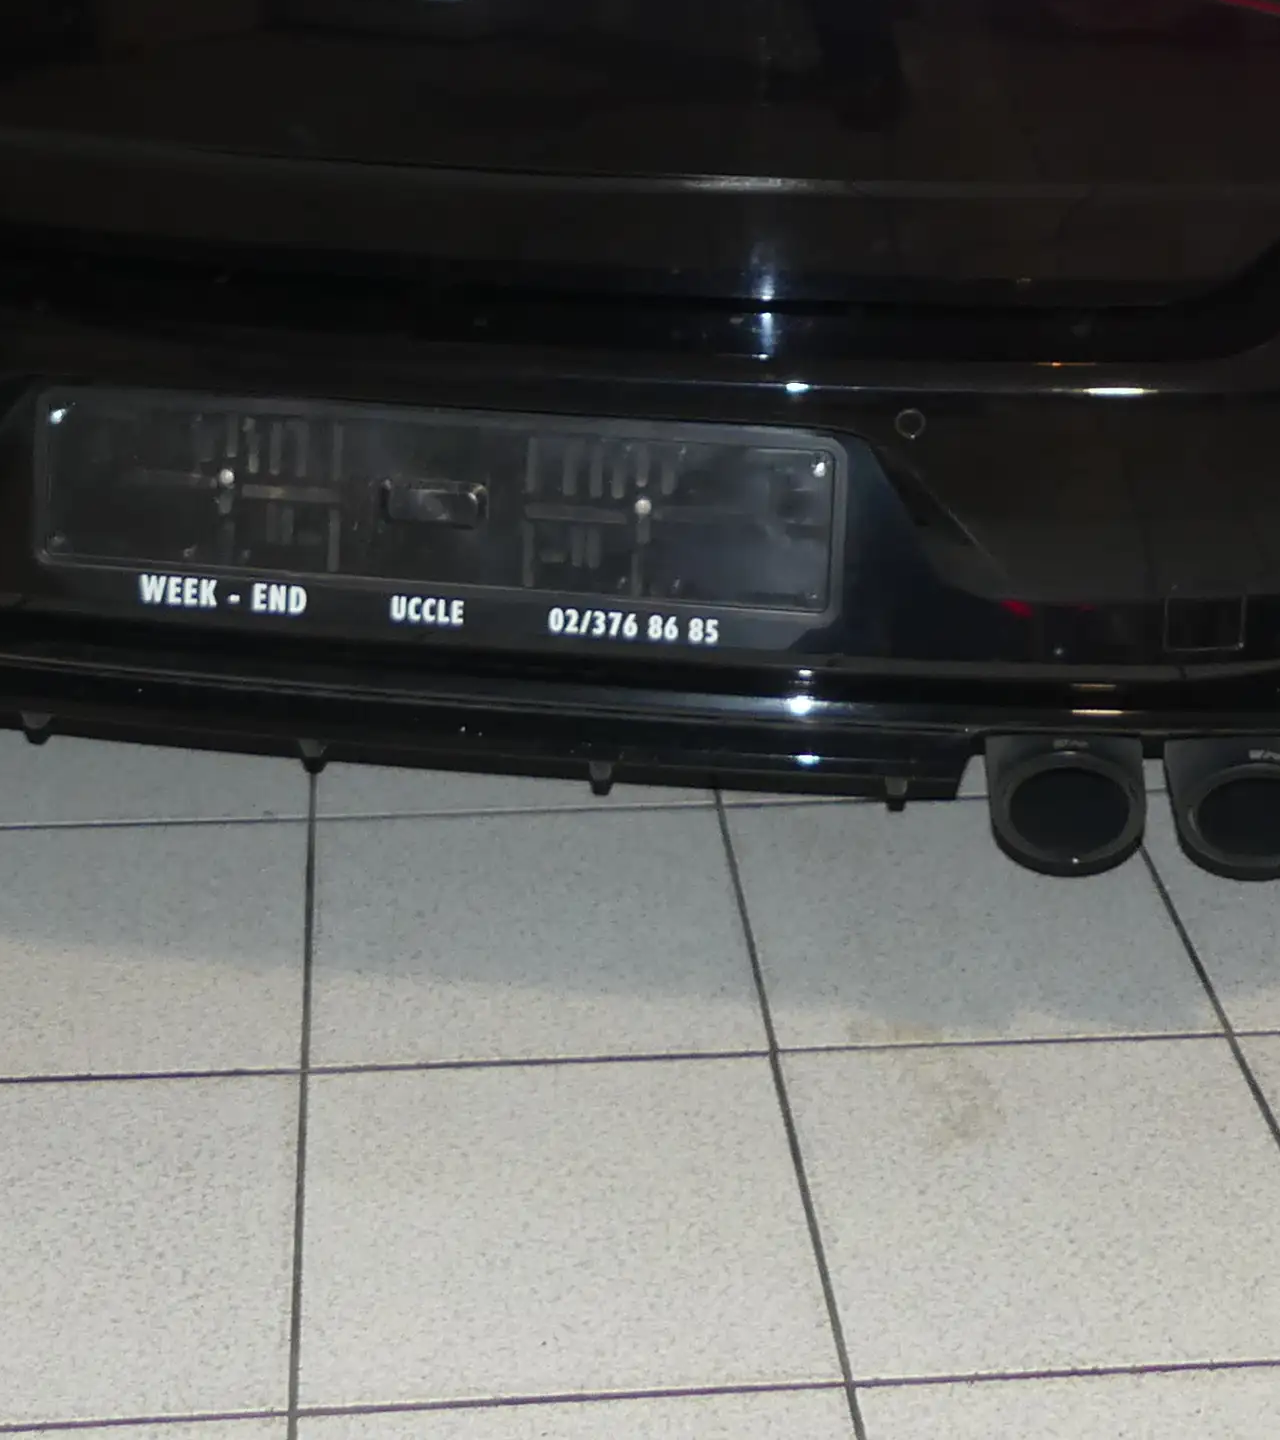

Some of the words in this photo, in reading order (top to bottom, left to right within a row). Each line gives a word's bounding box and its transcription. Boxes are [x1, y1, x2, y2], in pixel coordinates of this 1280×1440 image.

[138, 573, 218, 608] WEEK
[250, 582, 308, 616] END
[388, 594, 466, 627] UCCLE
[547, 607, 639, 639] 02/376
[646, 614, 680, 642] 86
[686, 617, 720, 645] 85
